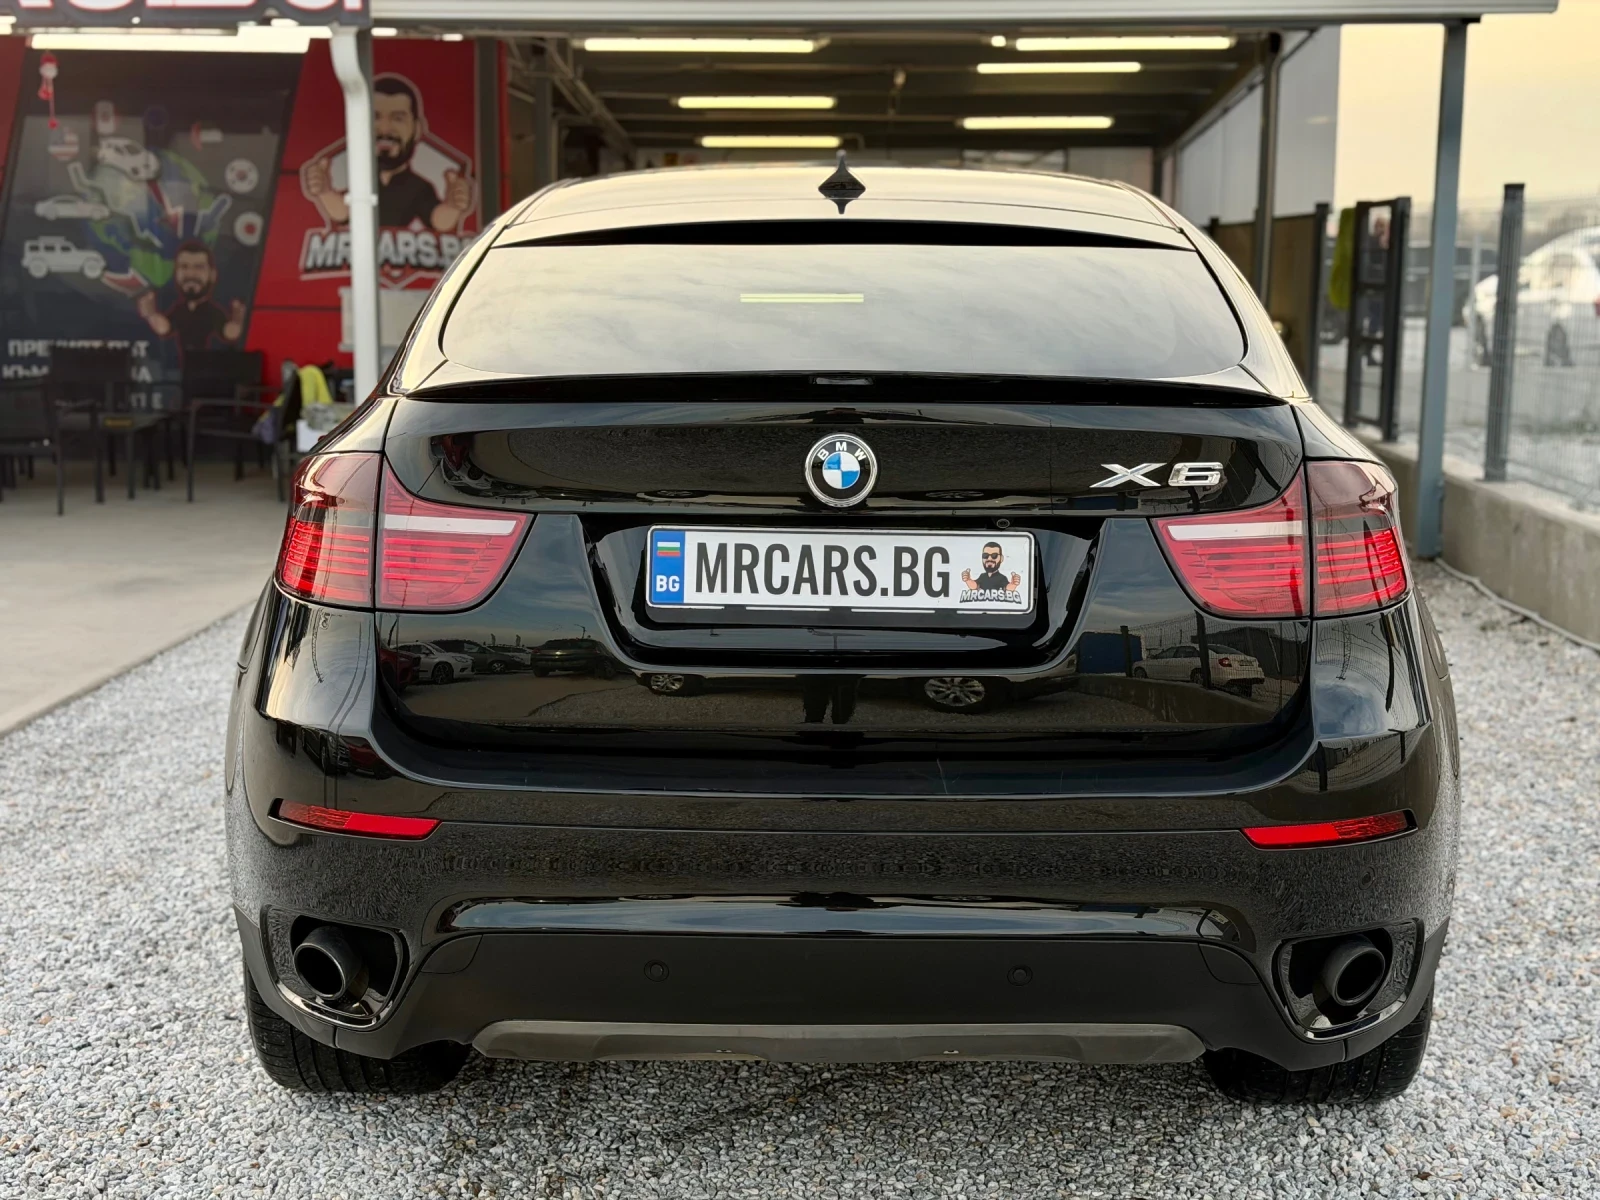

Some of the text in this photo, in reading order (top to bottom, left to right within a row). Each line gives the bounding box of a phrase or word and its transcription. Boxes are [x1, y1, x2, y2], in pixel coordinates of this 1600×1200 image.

[305, 231, 471, 270] MRARS.B
[817, 441, 867, 461] BMW
[1089, 462, 1224, 488] X6
[695, 541, 951, 598] MRCARS.BG
[655, 574, 681, 593] BG
[959, 588, 1021, 604] MRCARS.BG
